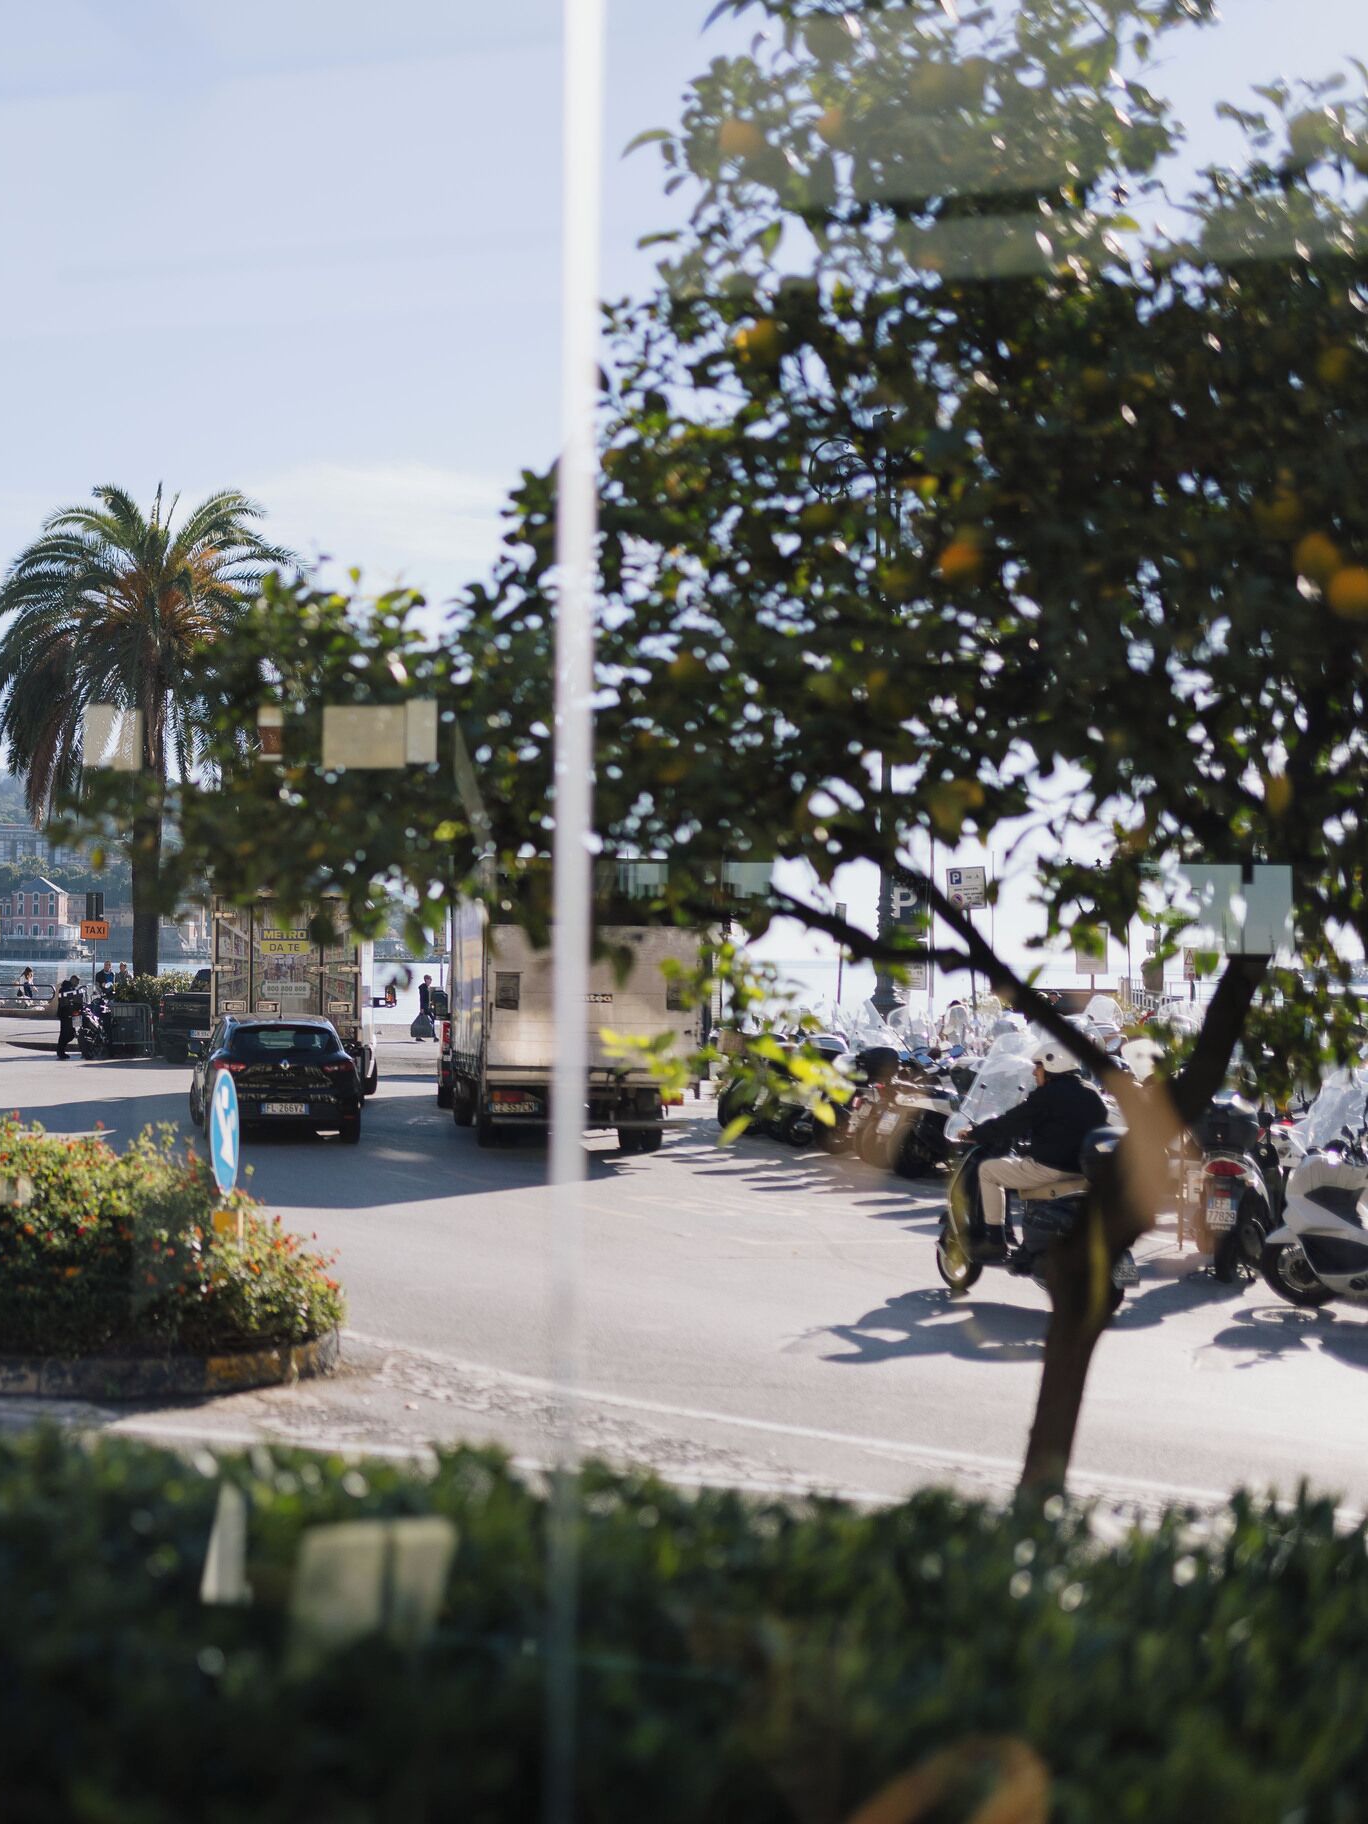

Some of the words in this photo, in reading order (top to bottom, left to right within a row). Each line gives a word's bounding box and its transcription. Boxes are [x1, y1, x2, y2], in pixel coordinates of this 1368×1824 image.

[84, 925, 105, 935] TAXI
[263, 930, 307, 939] METRO
[269, 943, 284, 952] DA
[288, 943, 300, 952] TE
[266, 1103, 277, 1113] FL
[1207, 1210, 1236, 1223] 77829
